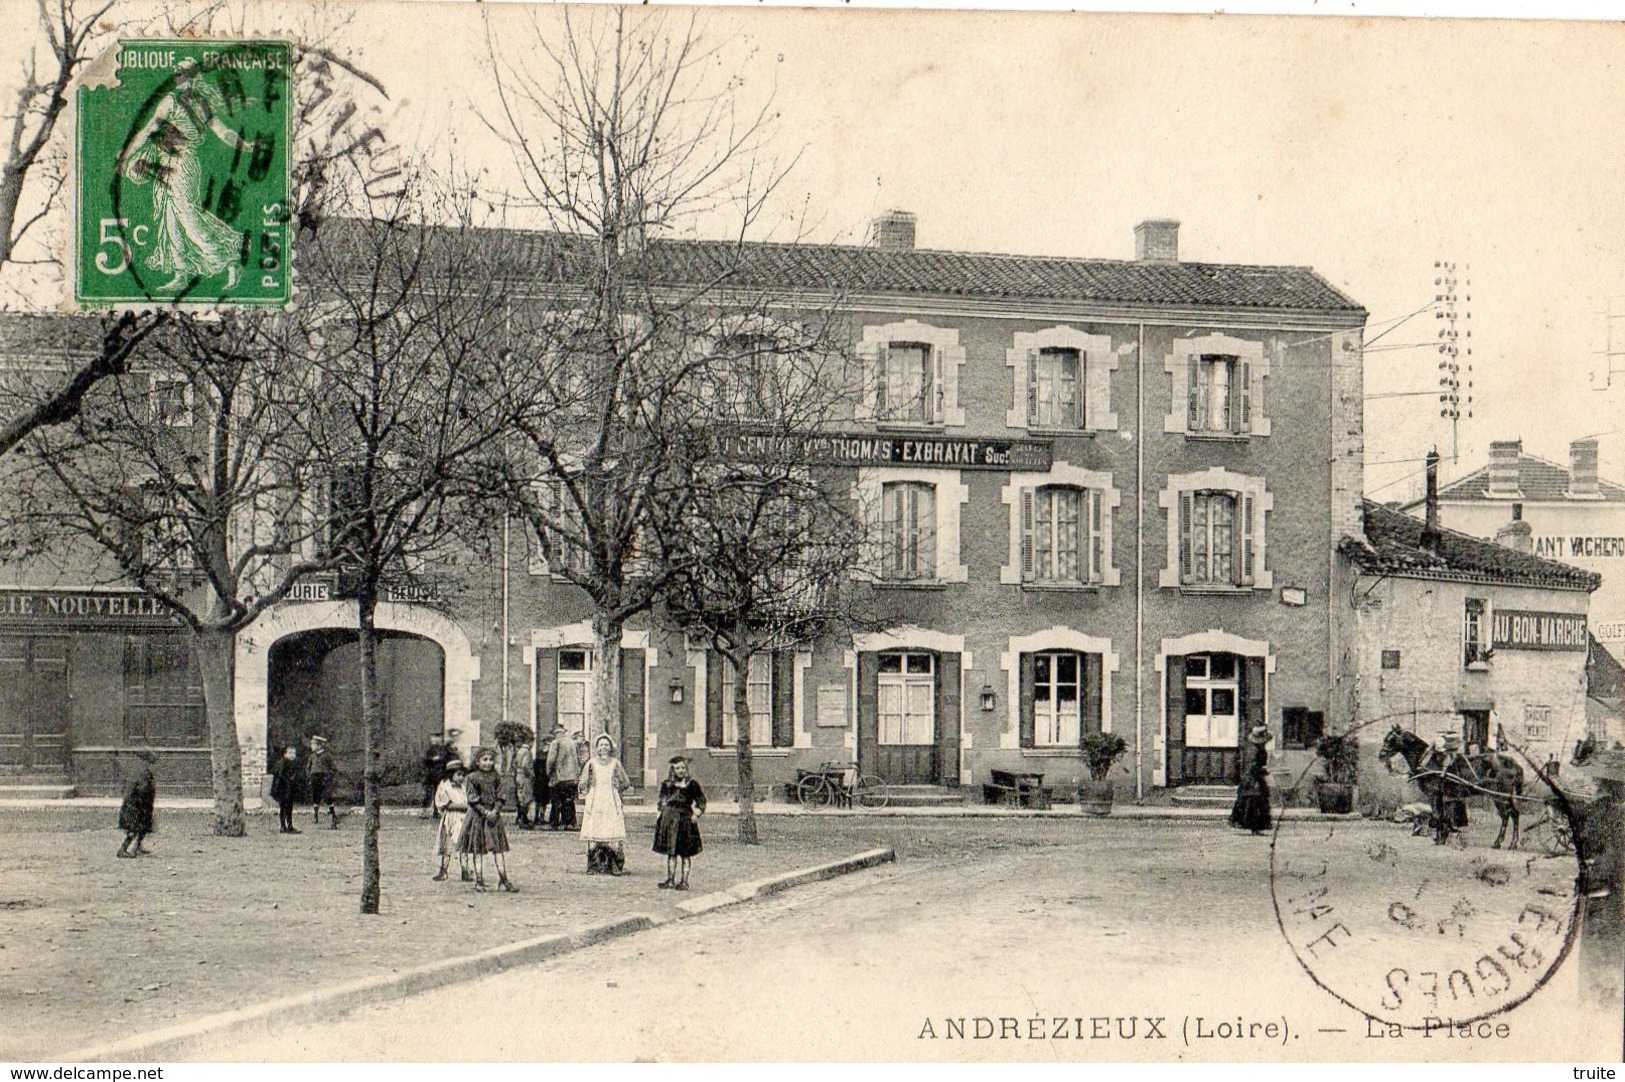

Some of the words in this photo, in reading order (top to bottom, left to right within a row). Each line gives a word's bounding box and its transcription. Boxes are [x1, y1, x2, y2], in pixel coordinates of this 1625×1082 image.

[203, 51, 283, 72] FRANÇAISE
[831, 439, 892, 460] THOMAS
[903, 441, 978, 464] EXBRAYAT
[46, 596, 165, 615] NOUVELLE
[1493, 615, 1510, 642] AU
[1598, 623, 1625, 640] COIF
